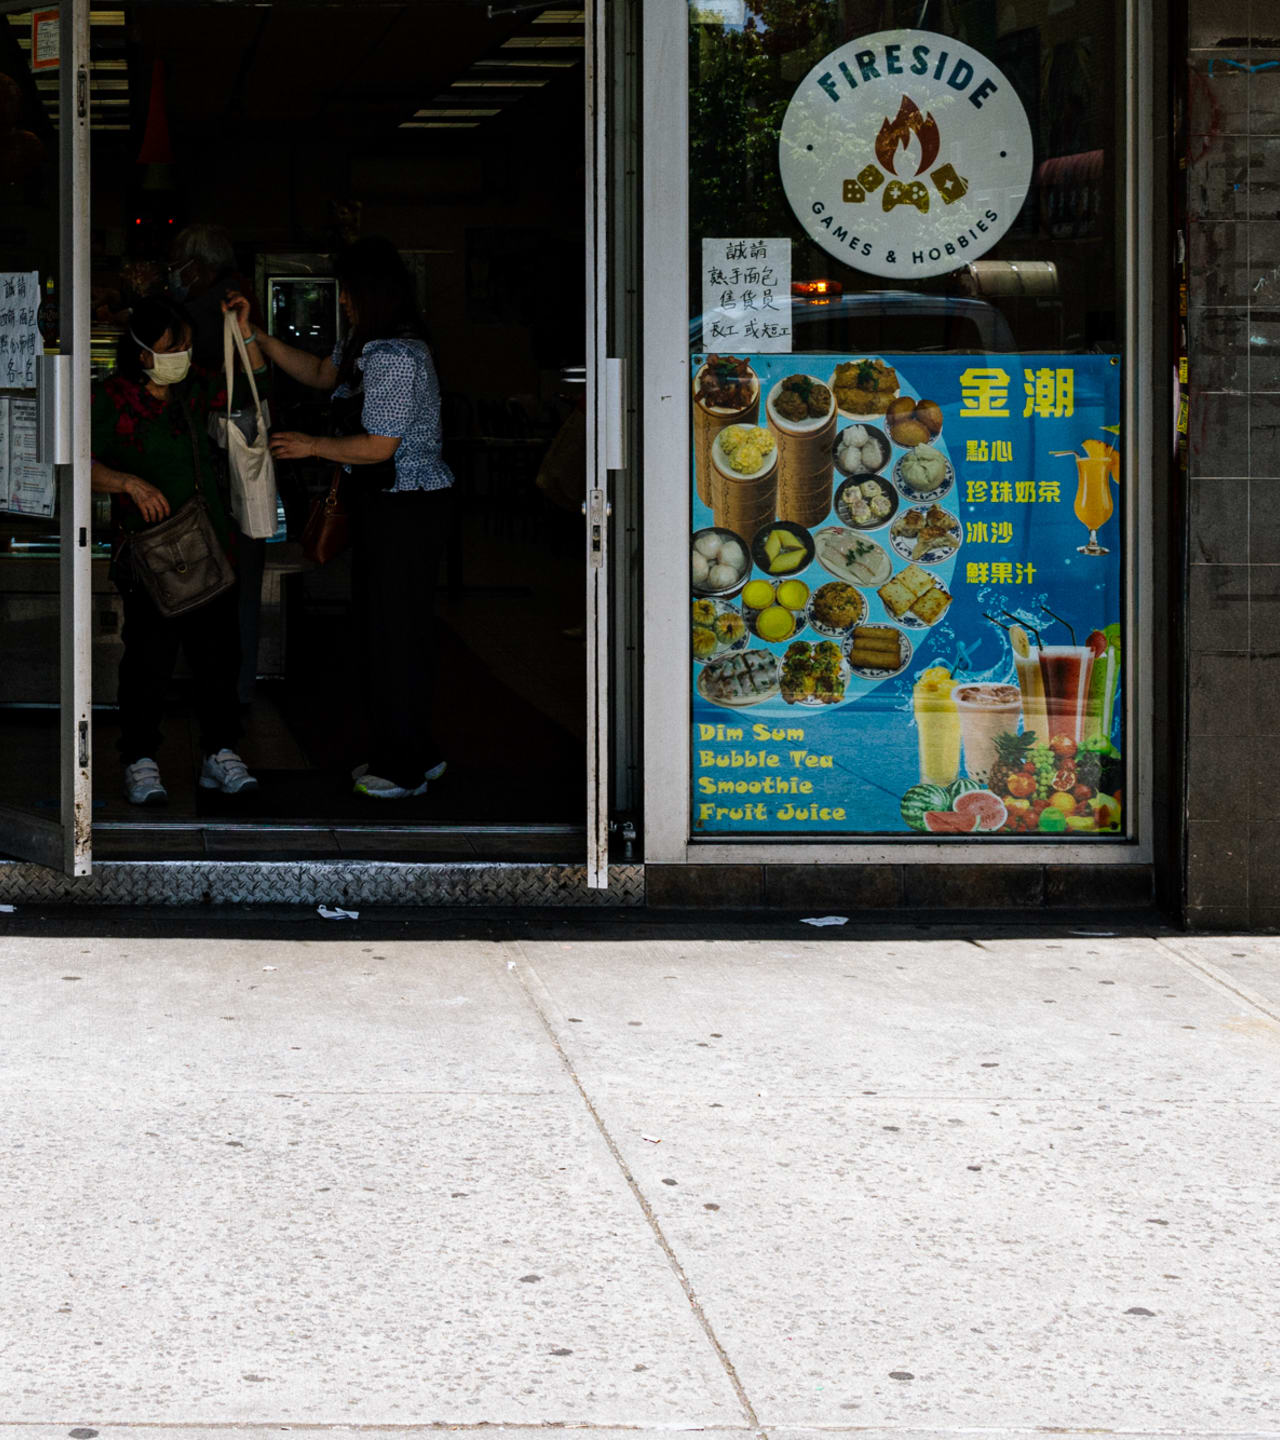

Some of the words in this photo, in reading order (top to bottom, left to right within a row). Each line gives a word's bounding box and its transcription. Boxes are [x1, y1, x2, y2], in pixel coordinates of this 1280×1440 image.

[816, 43, 999, 111] FIRESIDE
[812, 201, 873, 257] GAMES
[885, 250, 897, 264] &
[912, 208, 999, 265] HOBBIES
[958, 367, 1076, 419] 金潮
[965, 440, 1014, 463] 點心
[965, 480, 1062, 504] 珍珠奶茶
[965, 521, 1014, 545] 冰沙
[965, 562, 1038, 585] 鮮果汁
[698, 724, 744, 743] Dim
[752, 724, 805, 743] Sum
[699, 750, 780, 769] Bubble
[790, 750, 834, 769] Tea
[698, 776, 814, 795] Smoothie
[699, 803, 768, 822] Fruit
[777, 803, 847, 822] Juice
